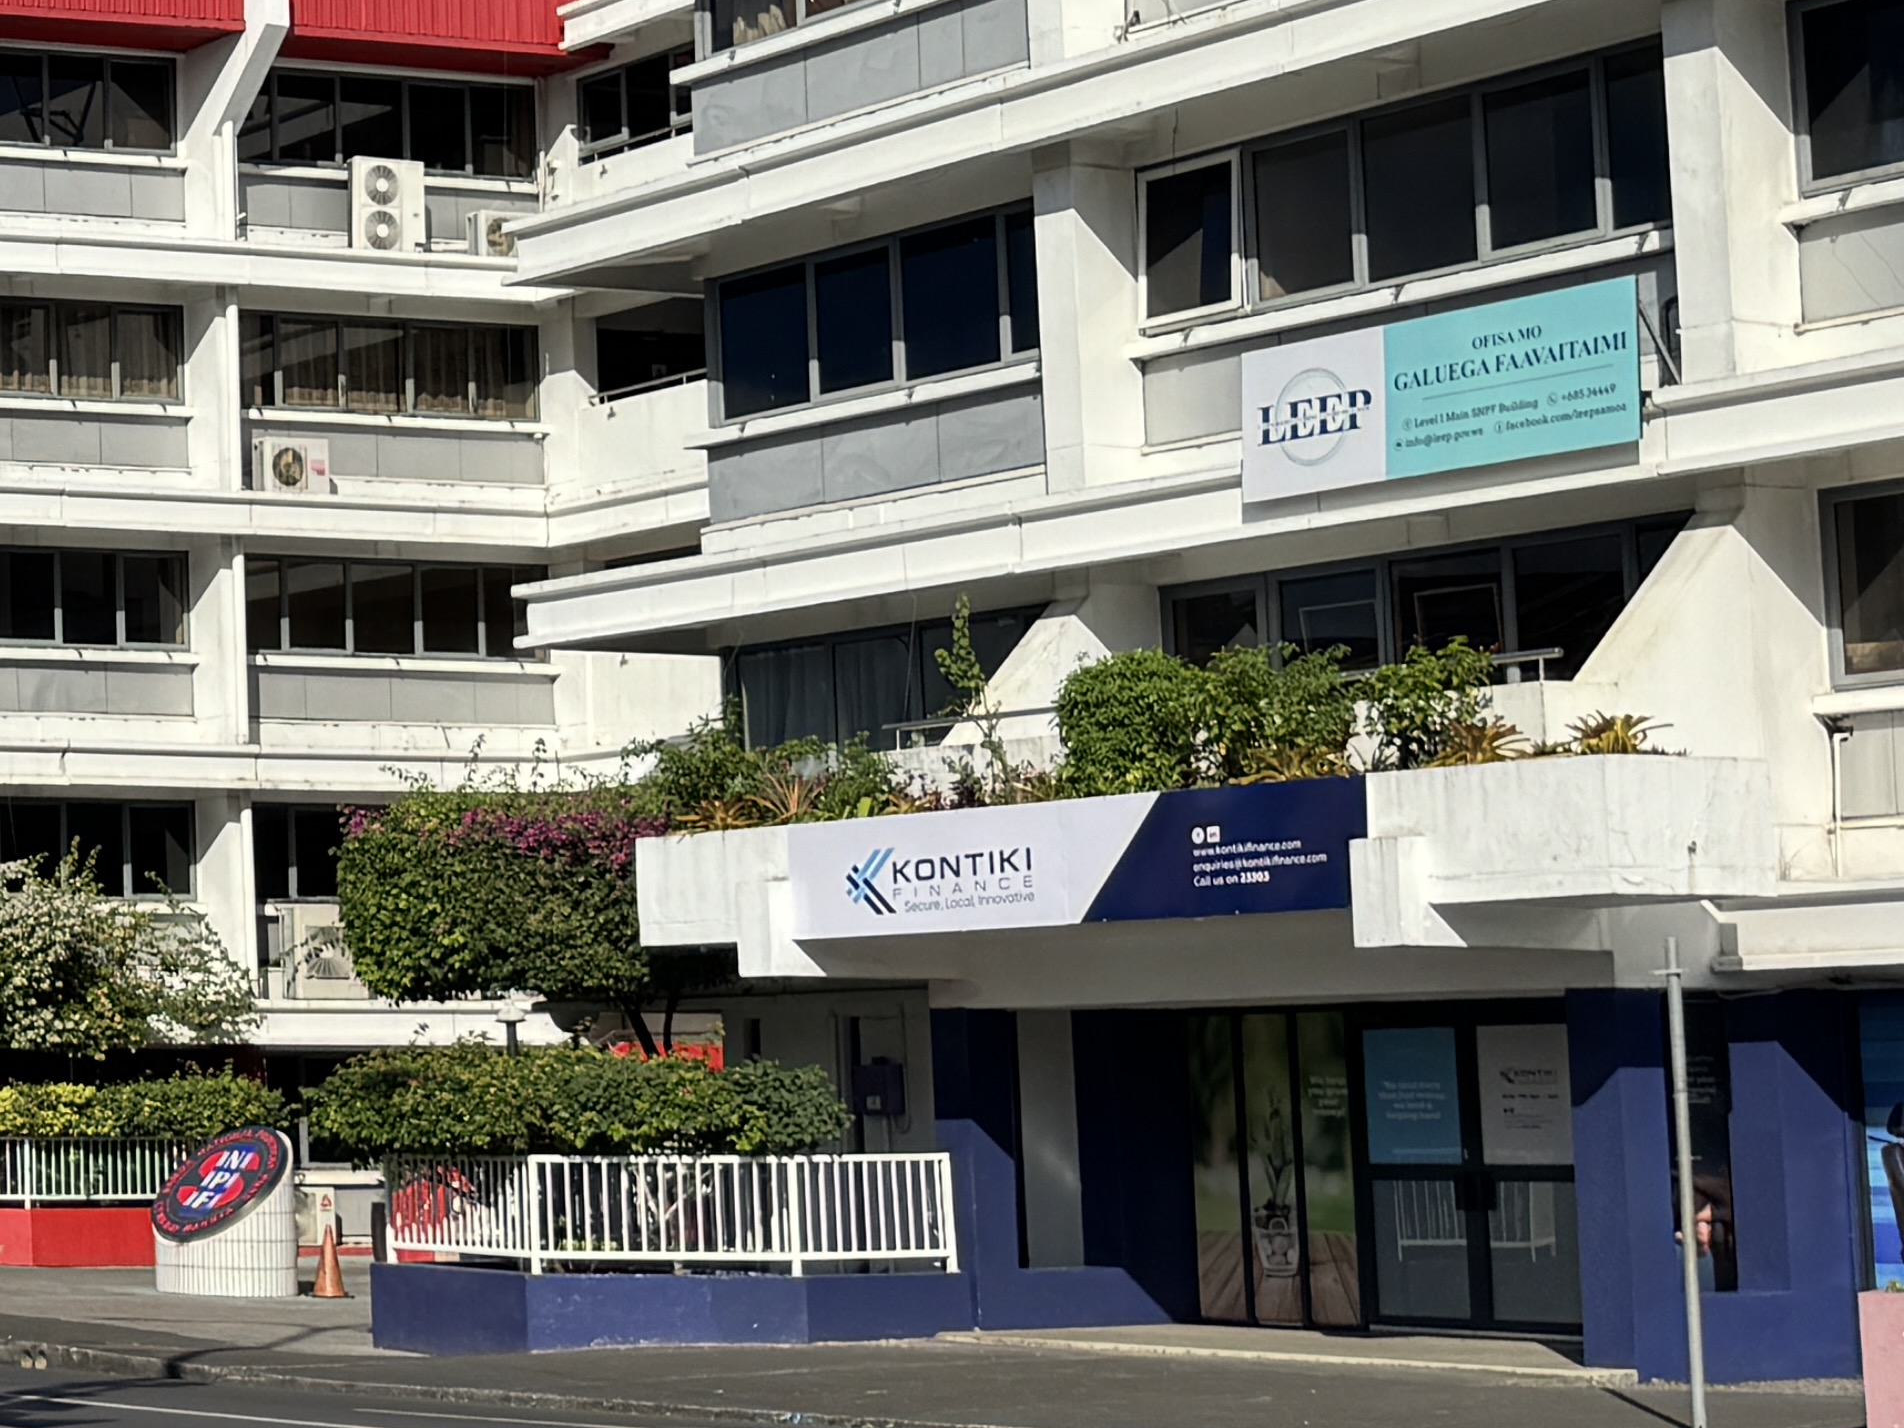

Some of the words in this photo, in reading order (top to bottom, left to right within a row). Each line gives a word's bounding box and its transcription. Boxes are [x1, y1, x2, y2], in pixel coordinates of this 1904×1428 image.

[1471, 329, 1514, 350] OFISA
[1517, 325, 1542, 342] MO
[1394, 357, 1490, 392] GALUEGA
[1495, 331, 1627, 373] FAAVAITAIMI
[1257, 389, 1372, 447] LEEP
[1414, 413, 1438, 427] Level
[1446, 409, 1469, 423] Main
[1499, 398, 1539, 414] Building
[1192, 840, 1301, 857] www.kontikifinance.com
[892, 847, 1032, 884] KONTIKI
[893, 875, 1033, 900] FINANCE
[1193, 875, 1211, 887] Call
[1213, 876, 1224, 885] us
[1226, 875, 1238, 884] on
[905, 900, 943, 913] Secure,
[978, 891, 1034, 905] Innovative
